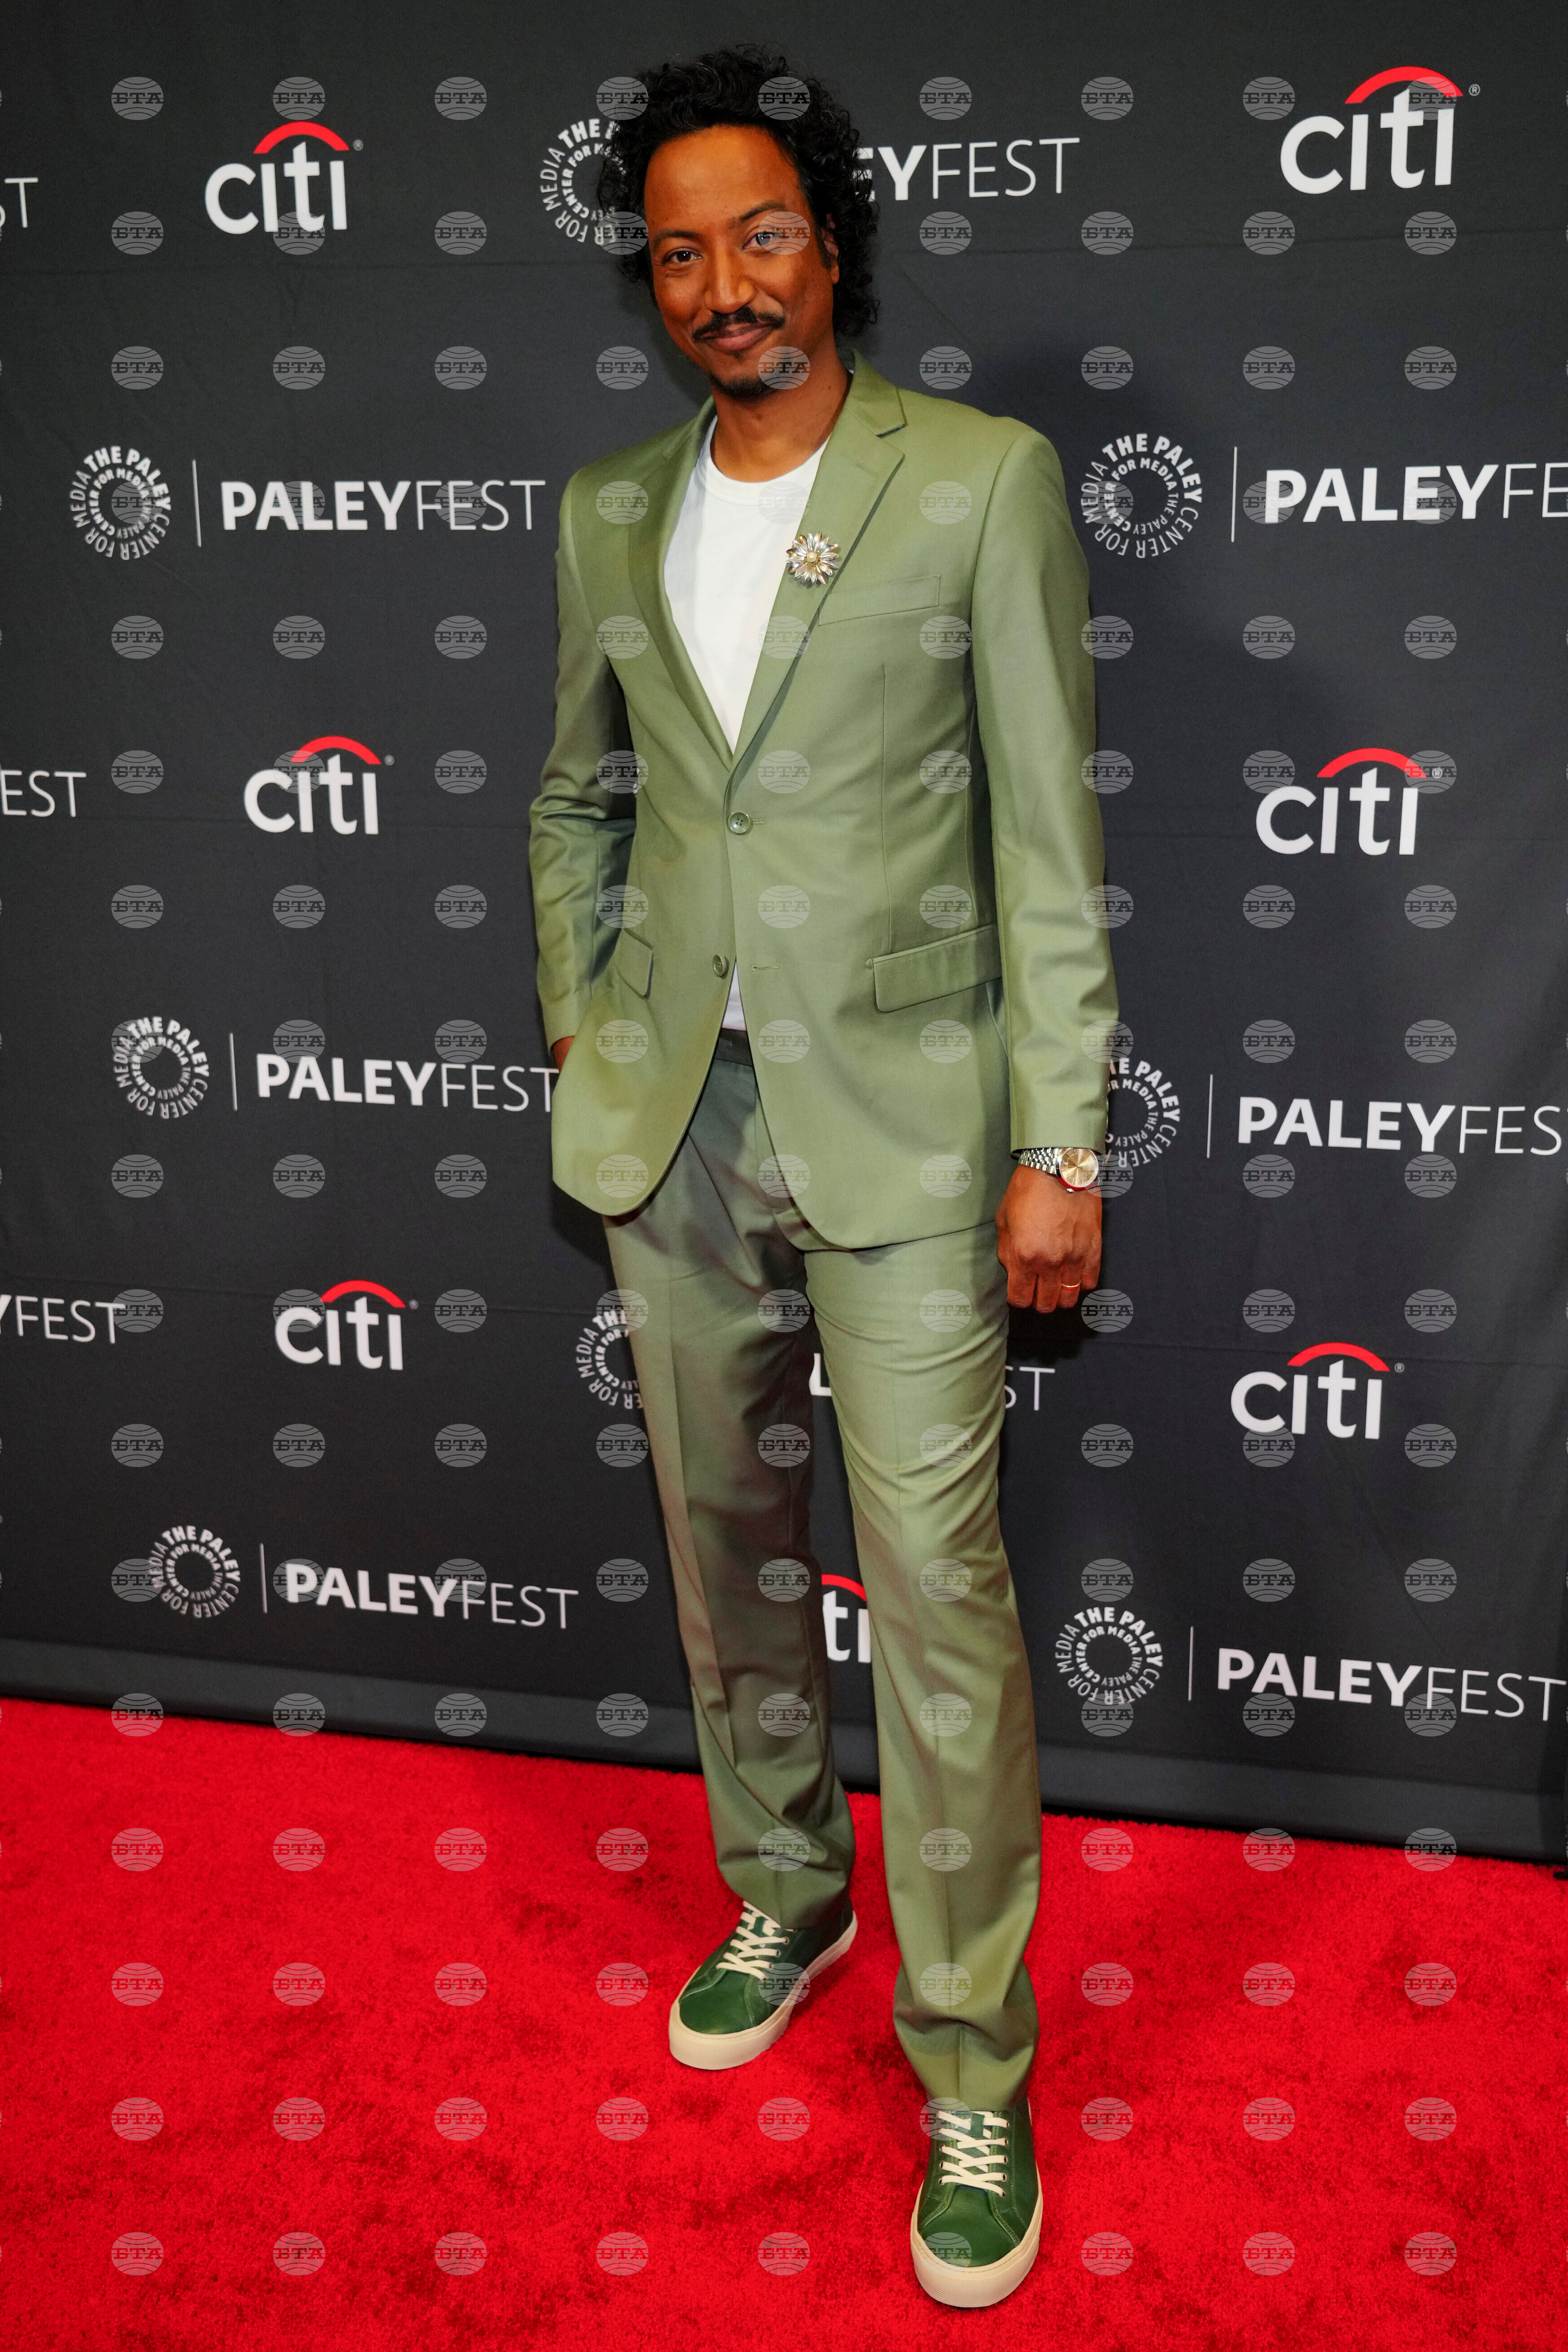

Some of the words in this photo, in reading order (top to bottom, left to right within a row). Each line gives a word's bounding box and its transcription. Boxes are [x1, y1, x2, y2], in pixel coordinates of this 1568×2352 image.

[558, 118, 601, 149] THE
[1281, 88, 1454, 194] citi
[568, 145, 591, 167] FOR
[205, 141, 347, 234] citi
[540, 147, 565, 211] MEDIA
[562, 168, 589, 219] CENTER
[555, 210, 588, 243] FOR
[84, 445, 122, 472] THE
[1102, 433, 1148, 462] THE
[126, 448, 172, 511] PALEY
[1111, 459, 1136, 481] FOR
[1140, 457, 1177, 491] MEDIA
[1153, 436, 1202, 503] PALEY
[70, 470, 92, 528] MEDIA
[221, 480, 545, 531] PALEYFEST
[1081, 461, 1109, 524] MEDIA
[1104, 482, 1131, 532] CENTER
[1164, 493, 1179, 515] THE
[85, 527, 115, 558] FOR
[119, 513, 170, 560] CENTER
[1095, 524, 1129, 556] FOR
[1133, 514, 1168, 535] PALEY
[1136, 507, 1198, 558] CENTER
[244, 754, 378, 834] citi
[1256, 768, 1418, 855] citi
[127, 1016, 163, 1039] THE
[167, 1019, 209, 1077] PALEY
[114, 1036, 134, 1088] MEDIA
[256, 1053, 559, 1113] PALEYFEST
[127, 1088, 155, 1116] FOR
[160, 1078, 208, 1119] CENTER
[1123, 1078, 1157, 1110] MEDIA
[1134, 1060, 1180, 1122] PALEY
[1115, 1129, 1148, 1147] PALEY
[1144, 1111, 1158, 1132] THE
[1238, 1097, 1568, 1155] PALEYFES
[1118, 1124, 1177, 1167] CENTER
[275, 1297, 403, 1370] citi
[576, 1328, 599, 1378] MEDIA
[589, 1378, 619, 1406] FOR
[1231, 1360, 1382, 1439] citi
[162, 1525, 197, 1546] THE
[200, 1528, 241, 1581] PALEY
[149, 1542, 169, 1588] MEDIA
[161, 1588, 189, 1615] FOR
[193, 1583, 239, 1618] CENTER
[286, 1563, 578, 1629] PALEYFEST
[1074, 1607, 1115, 1627] THE
[823, 1590, 871, 1663] ti
[1082, 1626, 1105, 1642] FOR
[1107, 1625, 1141, 1655] MEDIA
[1119, 1611, 1163, 1667] PALEY
[1055, 1624, 1080, 1673] MEDIA
[1075, 1642, 1101, 1683] CENTER
[1129, 1657, 1142, 1674] THE
[1067, 1674, 1099, 1701] FOR
[1101, 1672, 1133, 1686] PALEY
[1104, 1668, 1160, 1705] CENTER
[1217, 1647, 1567, 1721] PALEYFEST
